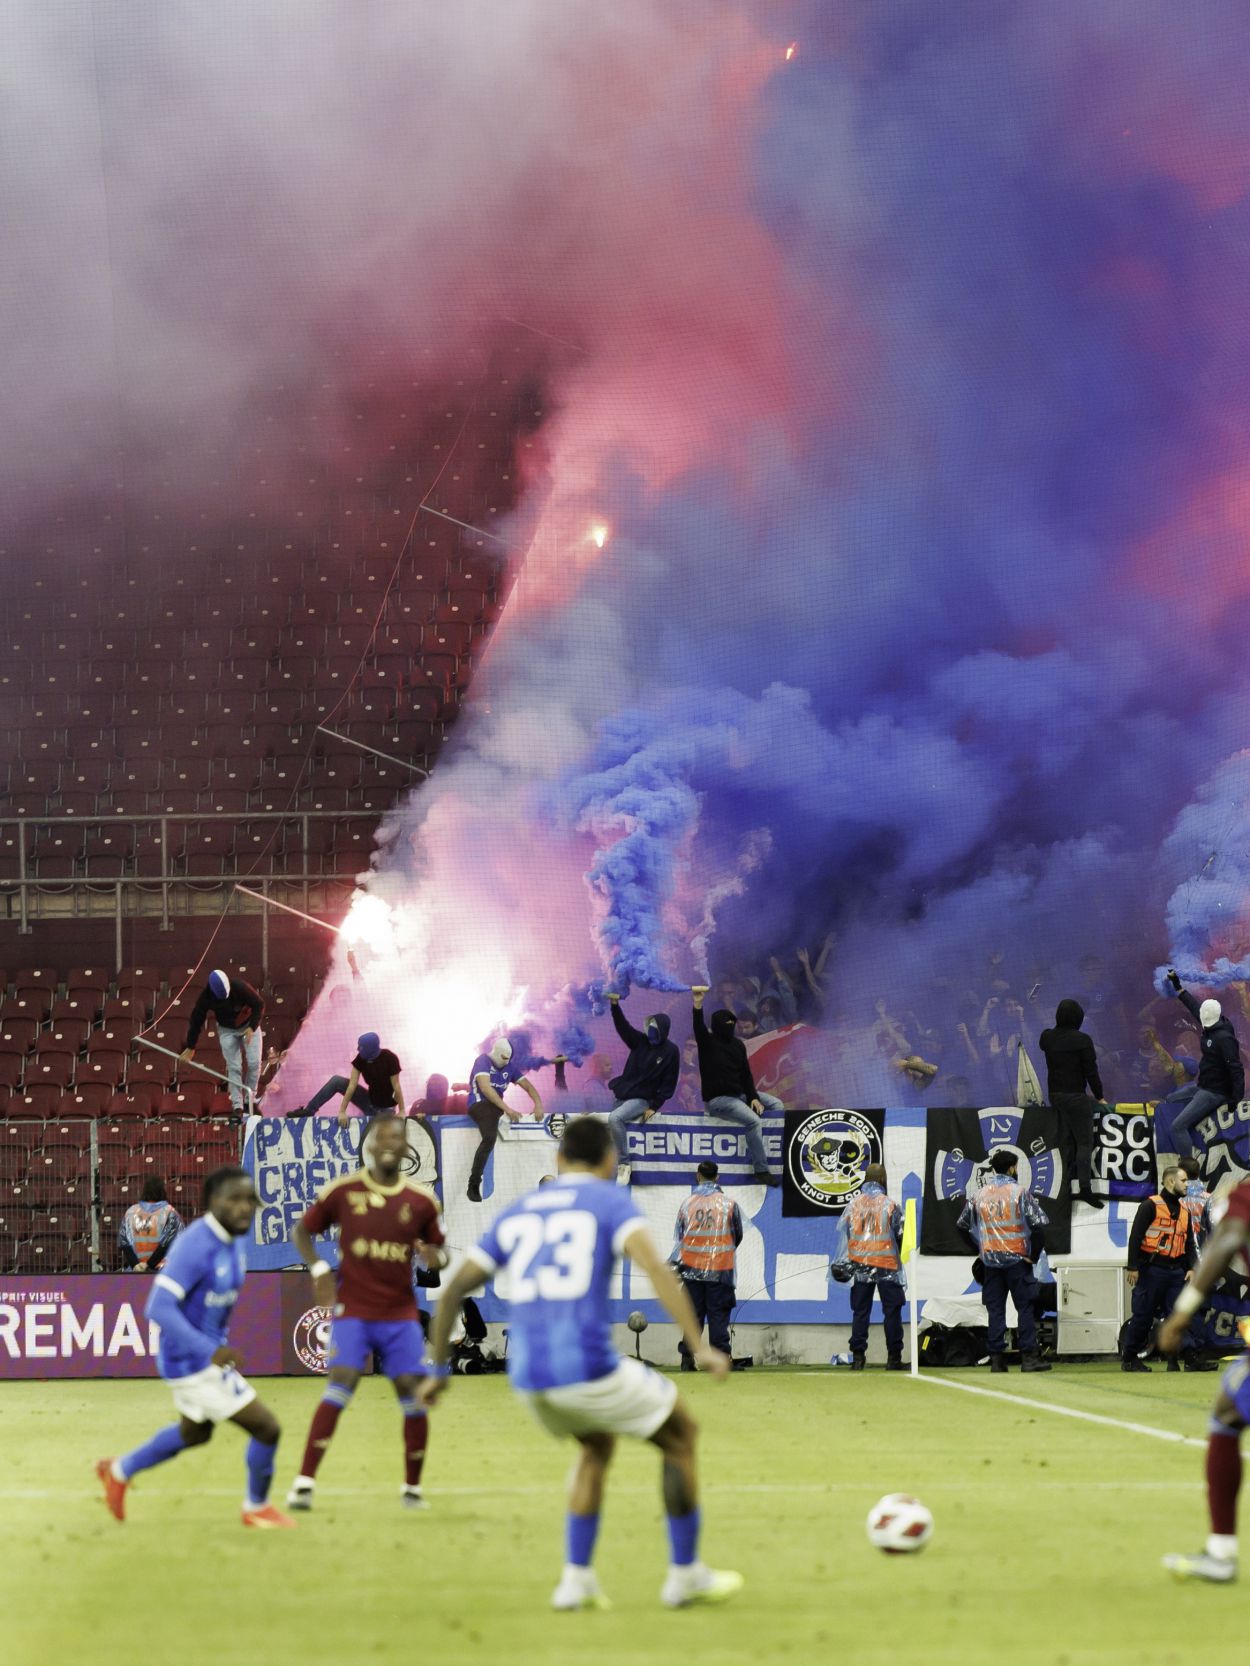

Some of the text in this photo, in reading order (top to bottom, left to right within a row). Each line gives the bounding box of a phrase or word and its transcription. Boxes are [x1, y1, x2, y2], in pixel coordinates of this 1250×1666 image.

[797, 1113, 875, 1142] GENECHE 2007
[801, 1182, 862, 1203] KNOT 200
[495, 1208, 598, 1304] 23
[29, 1292, 66, 1302] VISUEL
